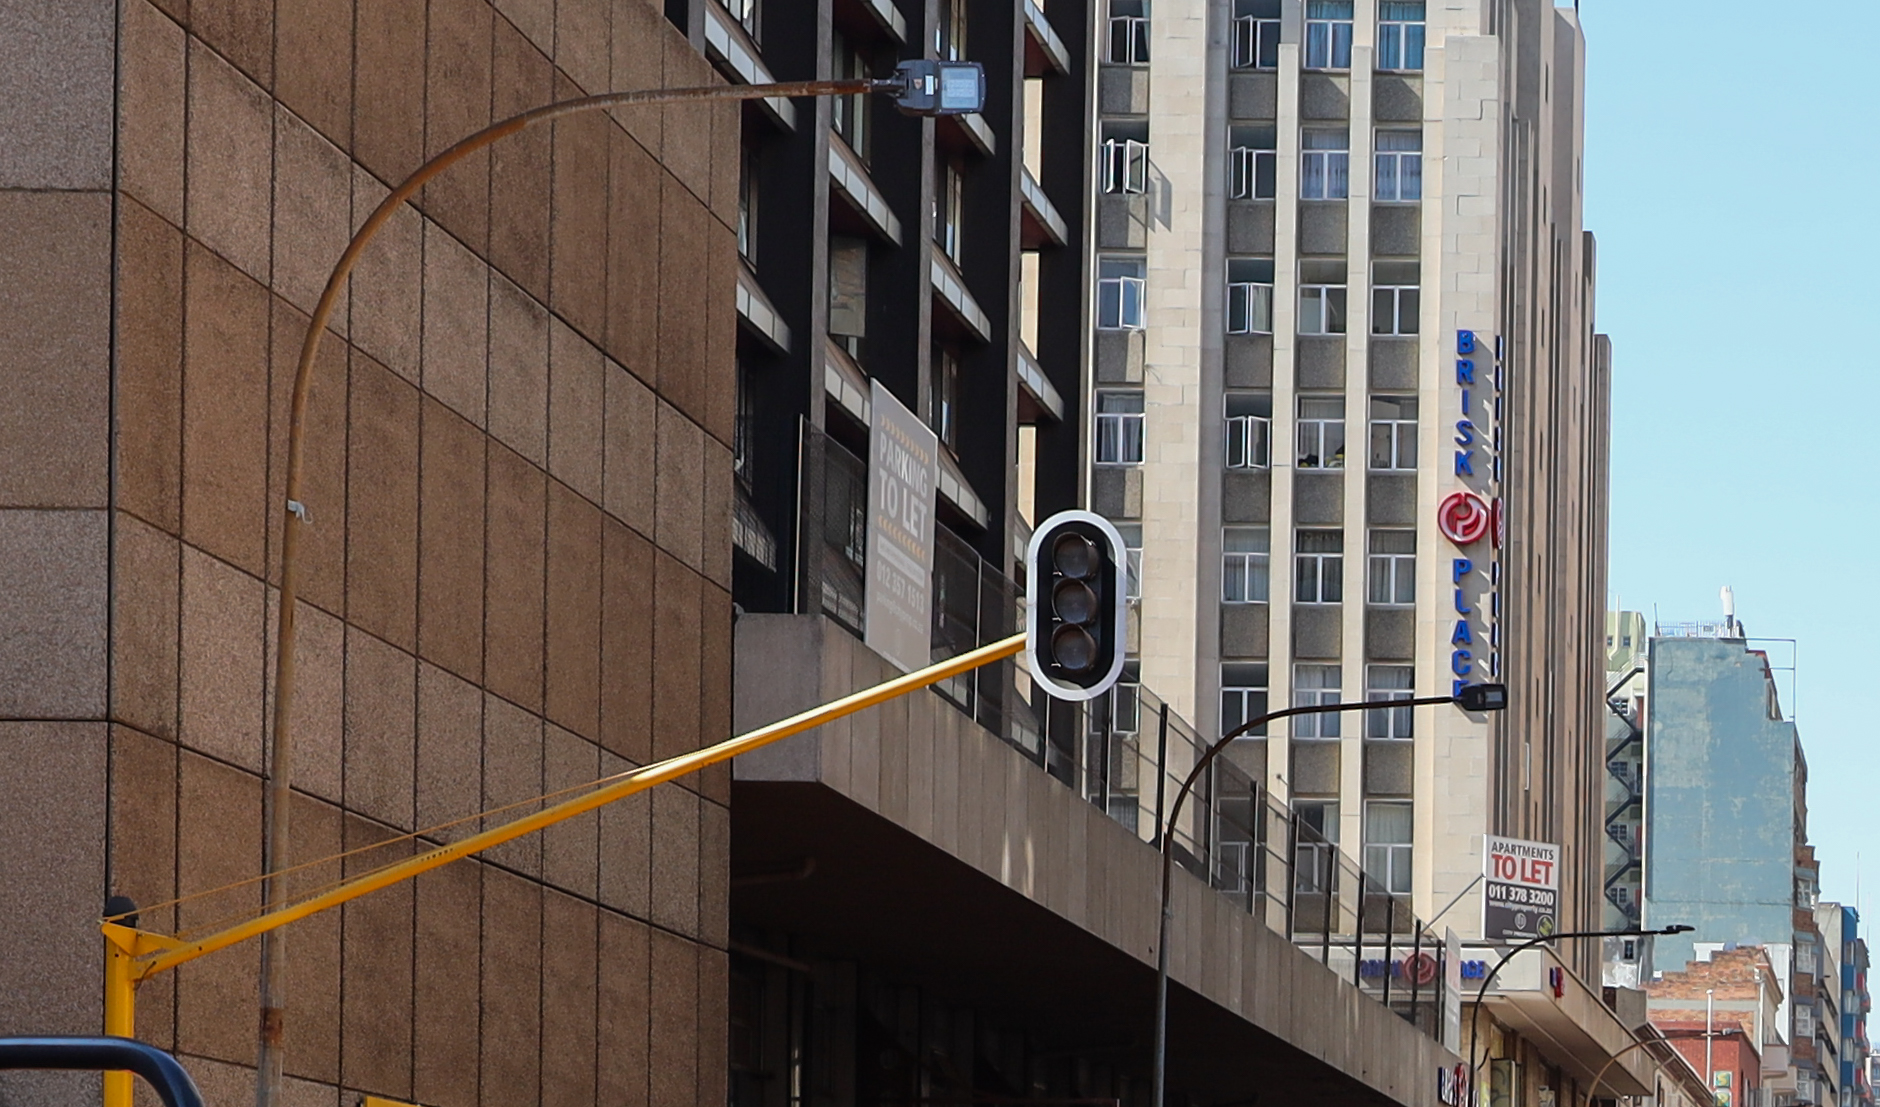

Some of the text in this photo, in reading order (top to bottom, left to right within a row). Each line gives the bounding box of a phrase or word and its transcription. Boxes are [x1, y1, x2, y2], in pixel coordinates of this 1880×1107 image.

[1454, 329, 1476, 477] BRISK
[879, 429, 928, 498] PARKING
[878, 469, 928, 544] TO LET
[876, 559, 891, 589] 012
[1491, 841, 1554, 860] APARTMENTS
[1491, 853, 1554, 885] TO LET
[1488, 884, 1554, 906] 011 378 3200
